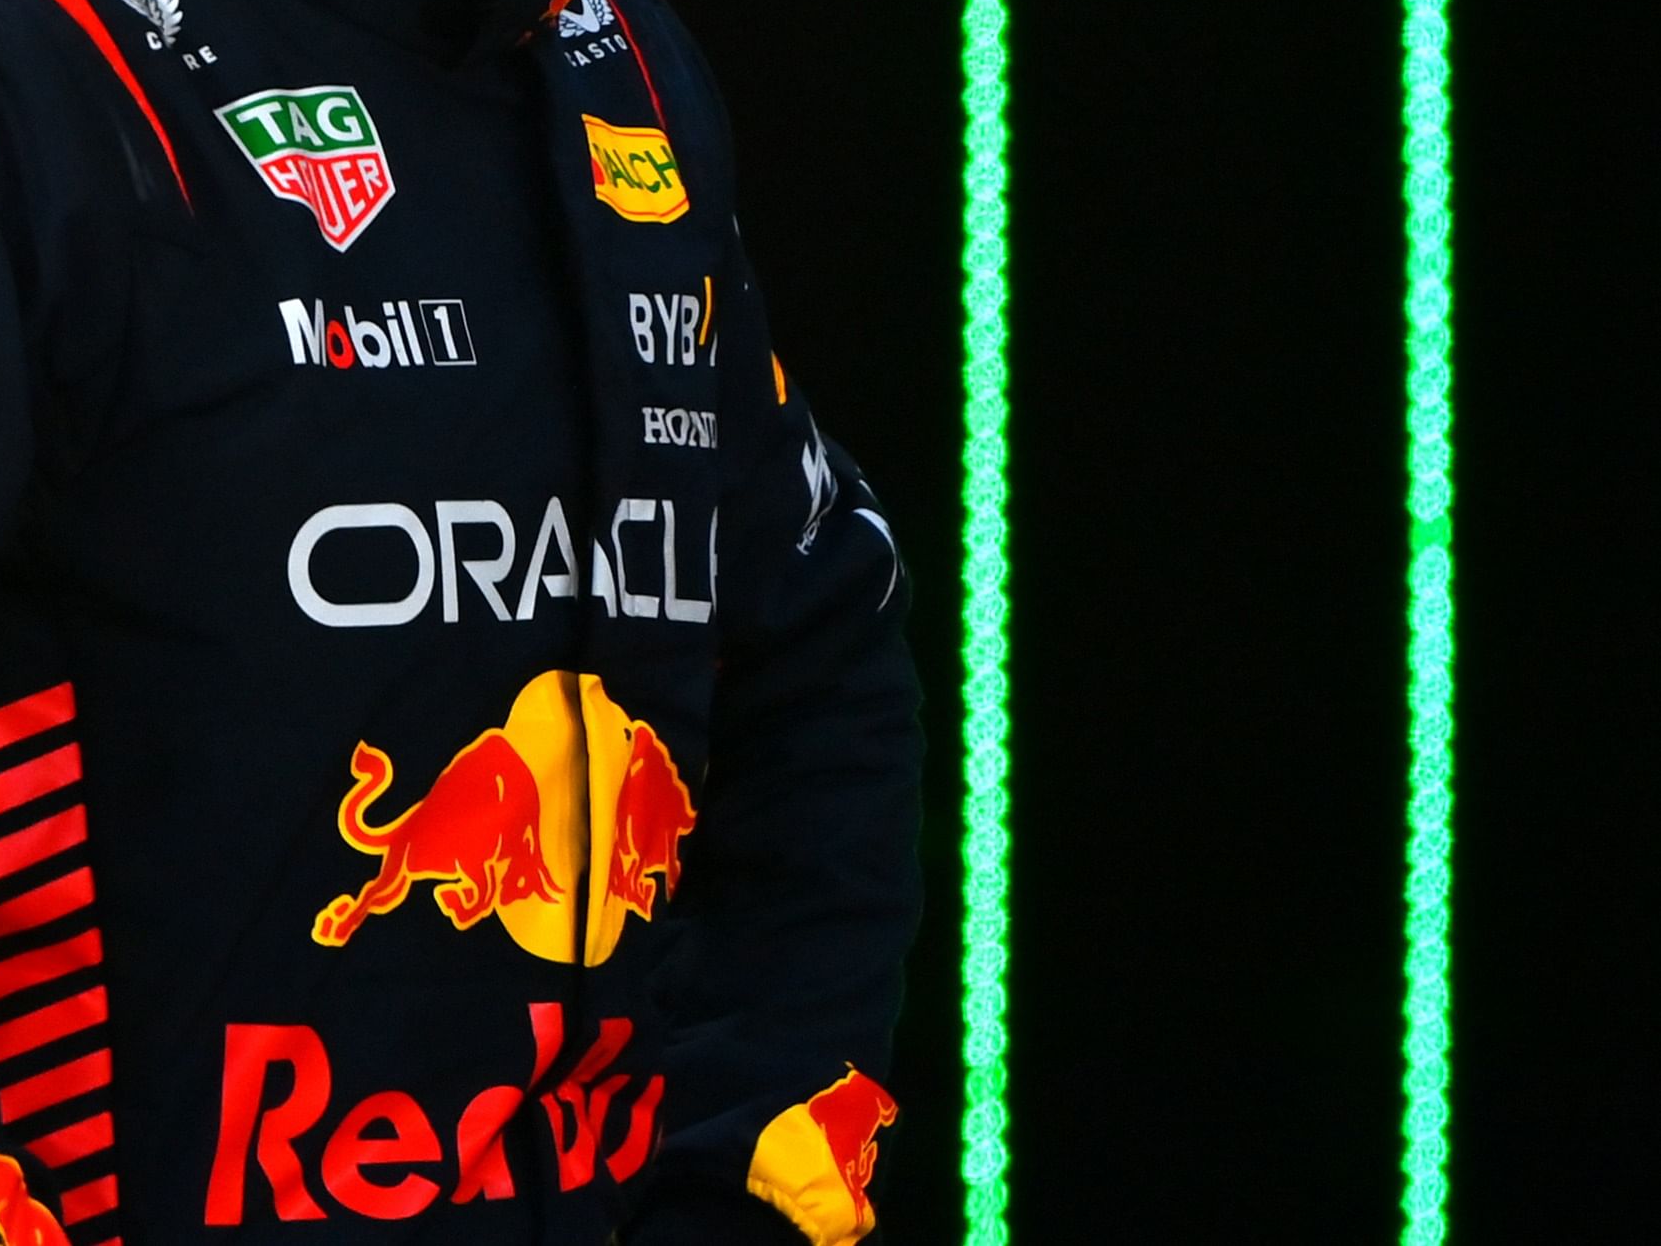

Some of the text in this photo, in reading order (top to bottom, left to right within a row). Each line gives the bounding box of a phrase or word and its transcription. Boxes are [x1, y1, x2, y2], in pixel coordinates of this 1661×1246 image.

[236, 97, 363, 147] TAG
[278, 297, 459, 370] Mobil 1
[287, 494, 719, 628] ORACL
